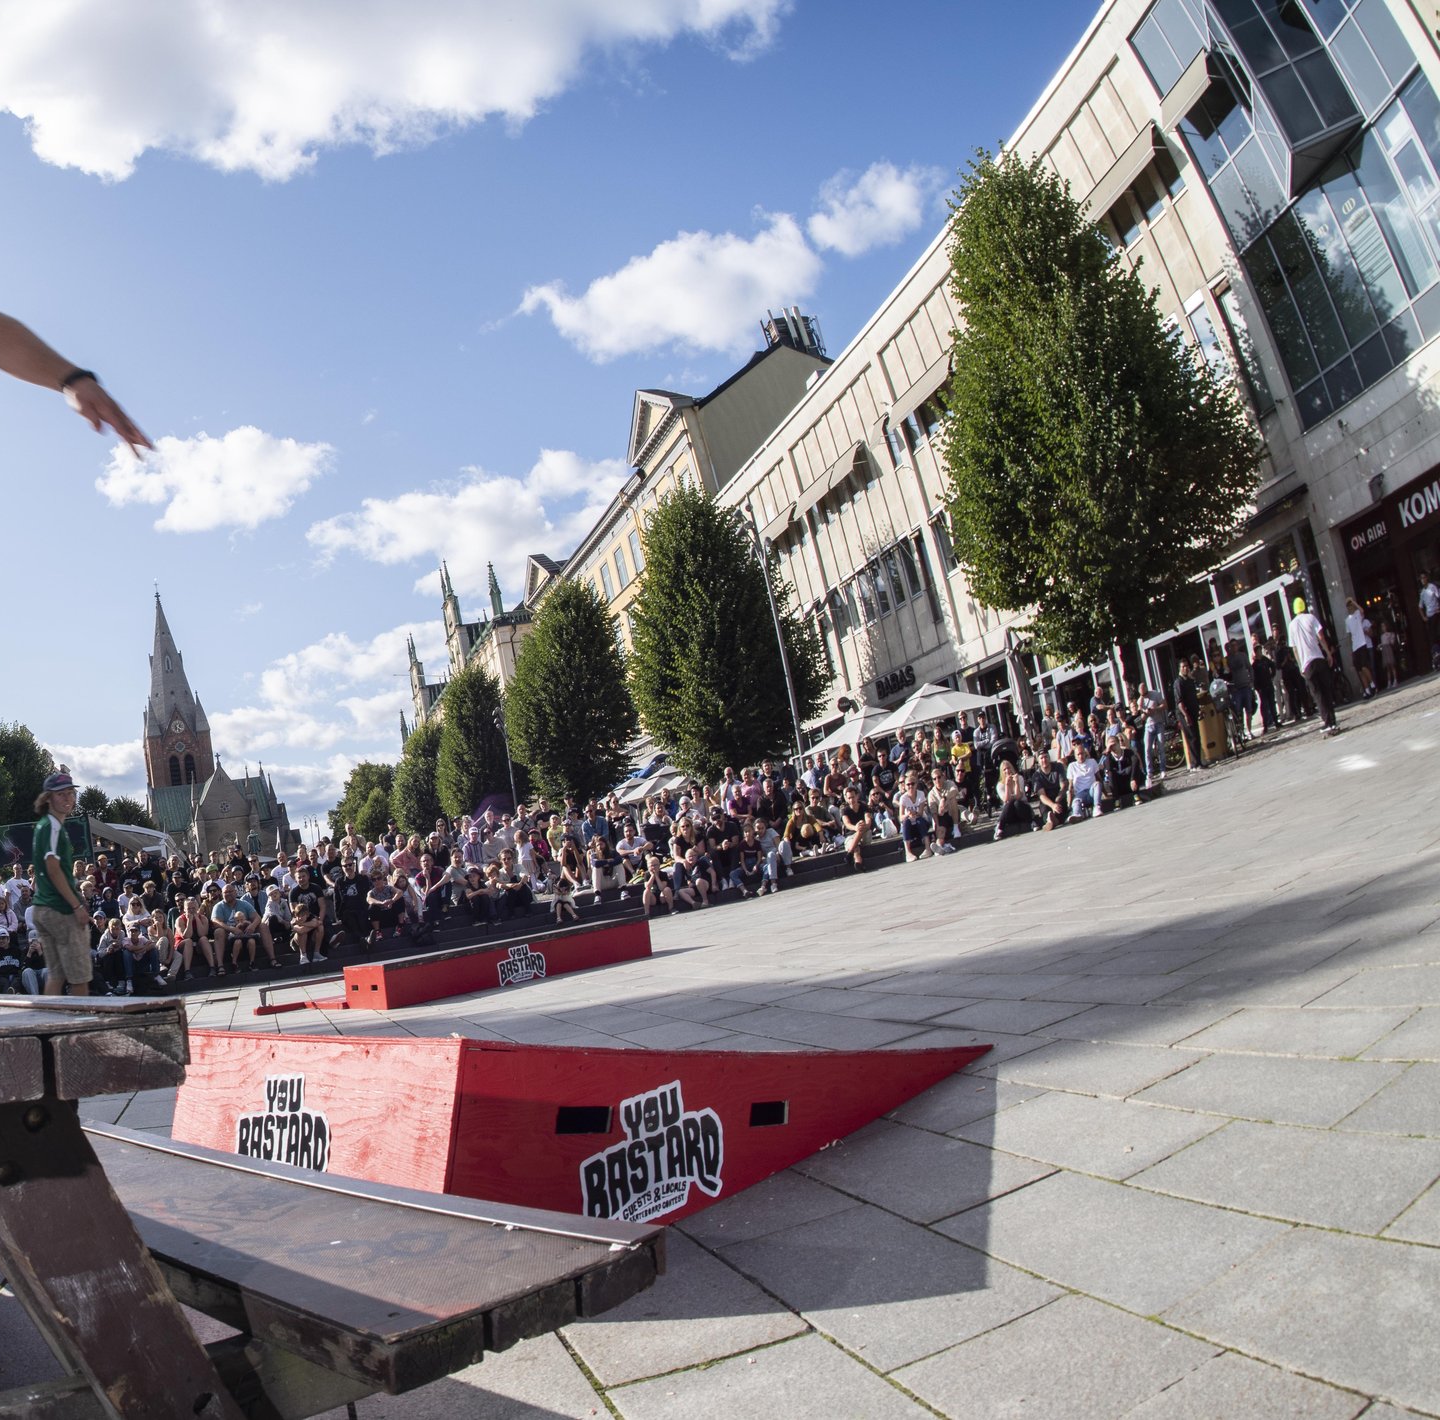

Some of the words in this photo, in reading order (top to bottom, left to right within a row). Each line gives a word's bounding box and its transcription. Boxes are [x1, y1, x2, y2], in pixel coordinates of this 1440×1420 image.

[1398, 479, 1440, 528] KOM
[1350, 532, 1367, 550] ON
[1366, 521, 1387, 542] AIR!
[875, 665, 916, 700] BABAS
[498, 953, 546, 982] BASTARD
[510, 945, 529, 959] YOU
[266, 1078, 302, 1113] YOU
[624, 1086, 680, 1140] YOU
[238, 1113, 328, 1172] BASTARD
[584, 1114, 720, 1218] BASTARD
[622, 1190, 652, 1220] GUESTS
[653, 1187, 661, 1203] &
[661, 1180, 687, 1195] LOCALS
[629, 1203, 661, 1222] SKATEBOARD
[662, 1193, 685, 1209] CONTEST
